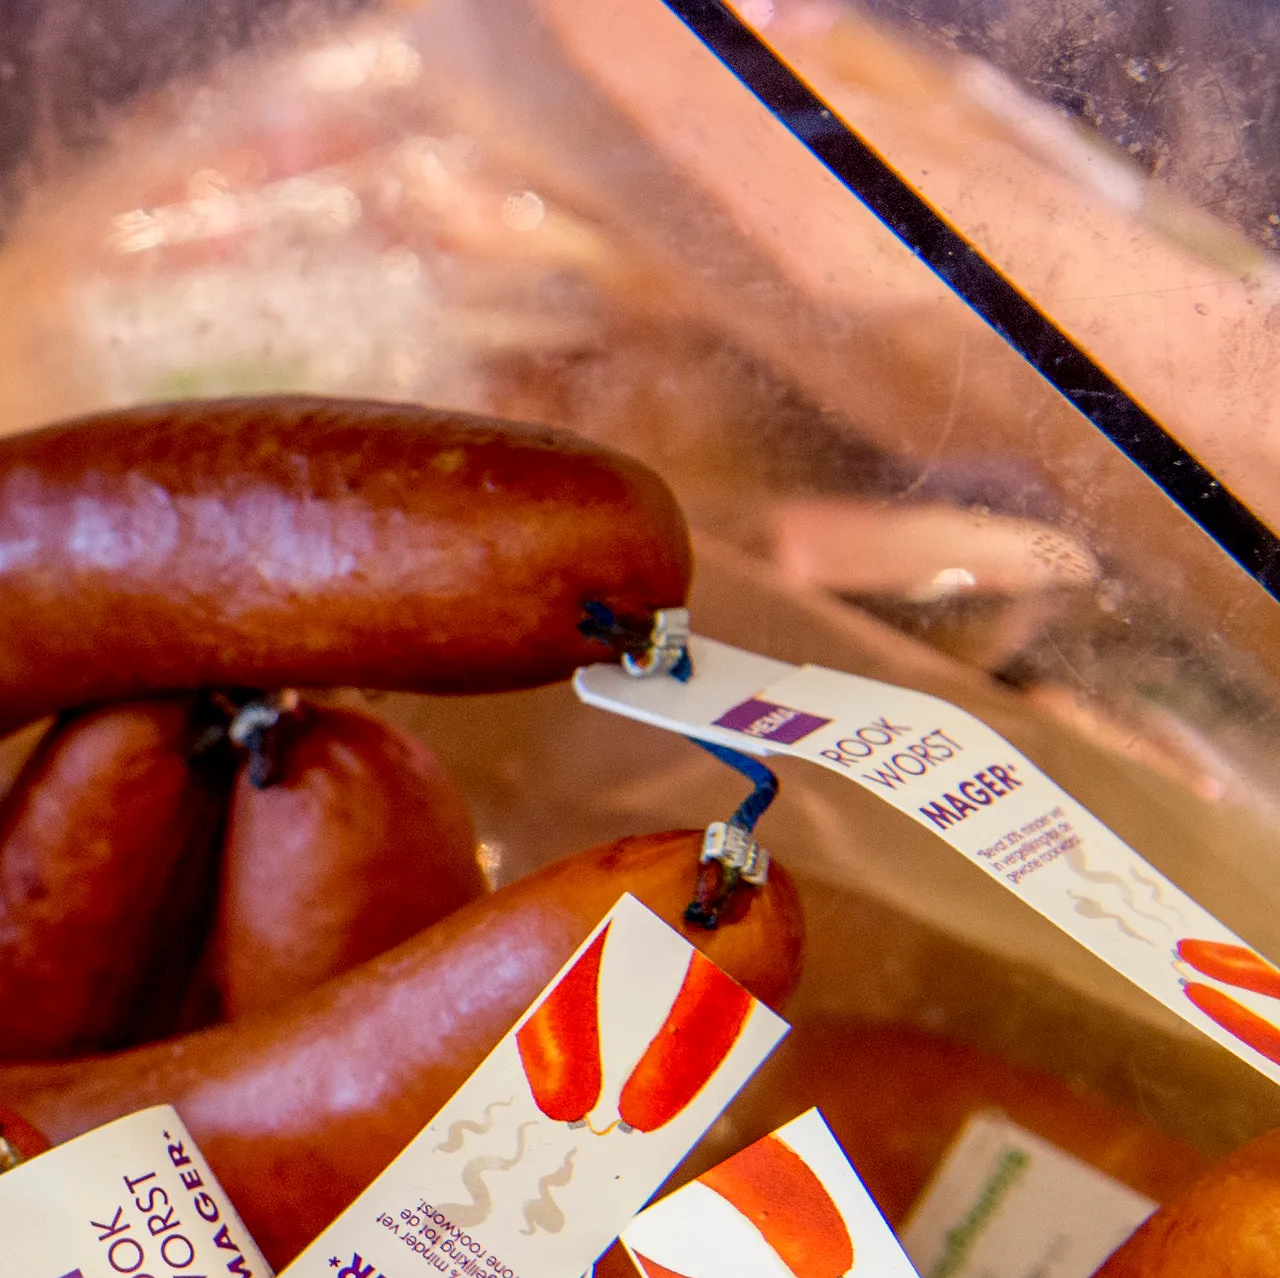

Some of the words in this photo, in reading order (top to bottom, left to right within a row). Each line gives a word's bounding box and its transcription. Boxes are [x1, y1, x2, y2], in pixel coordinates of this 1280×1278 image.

[820, 717, 912, 767] ROOK
[862, 728, 963, 790] WORST
[375, 1212, 400, 1235] vet
[399, 1208, 421, 1227] de
[418, 1224, 442, 1246] tot
[399, 1231, 450, 1273] minder
